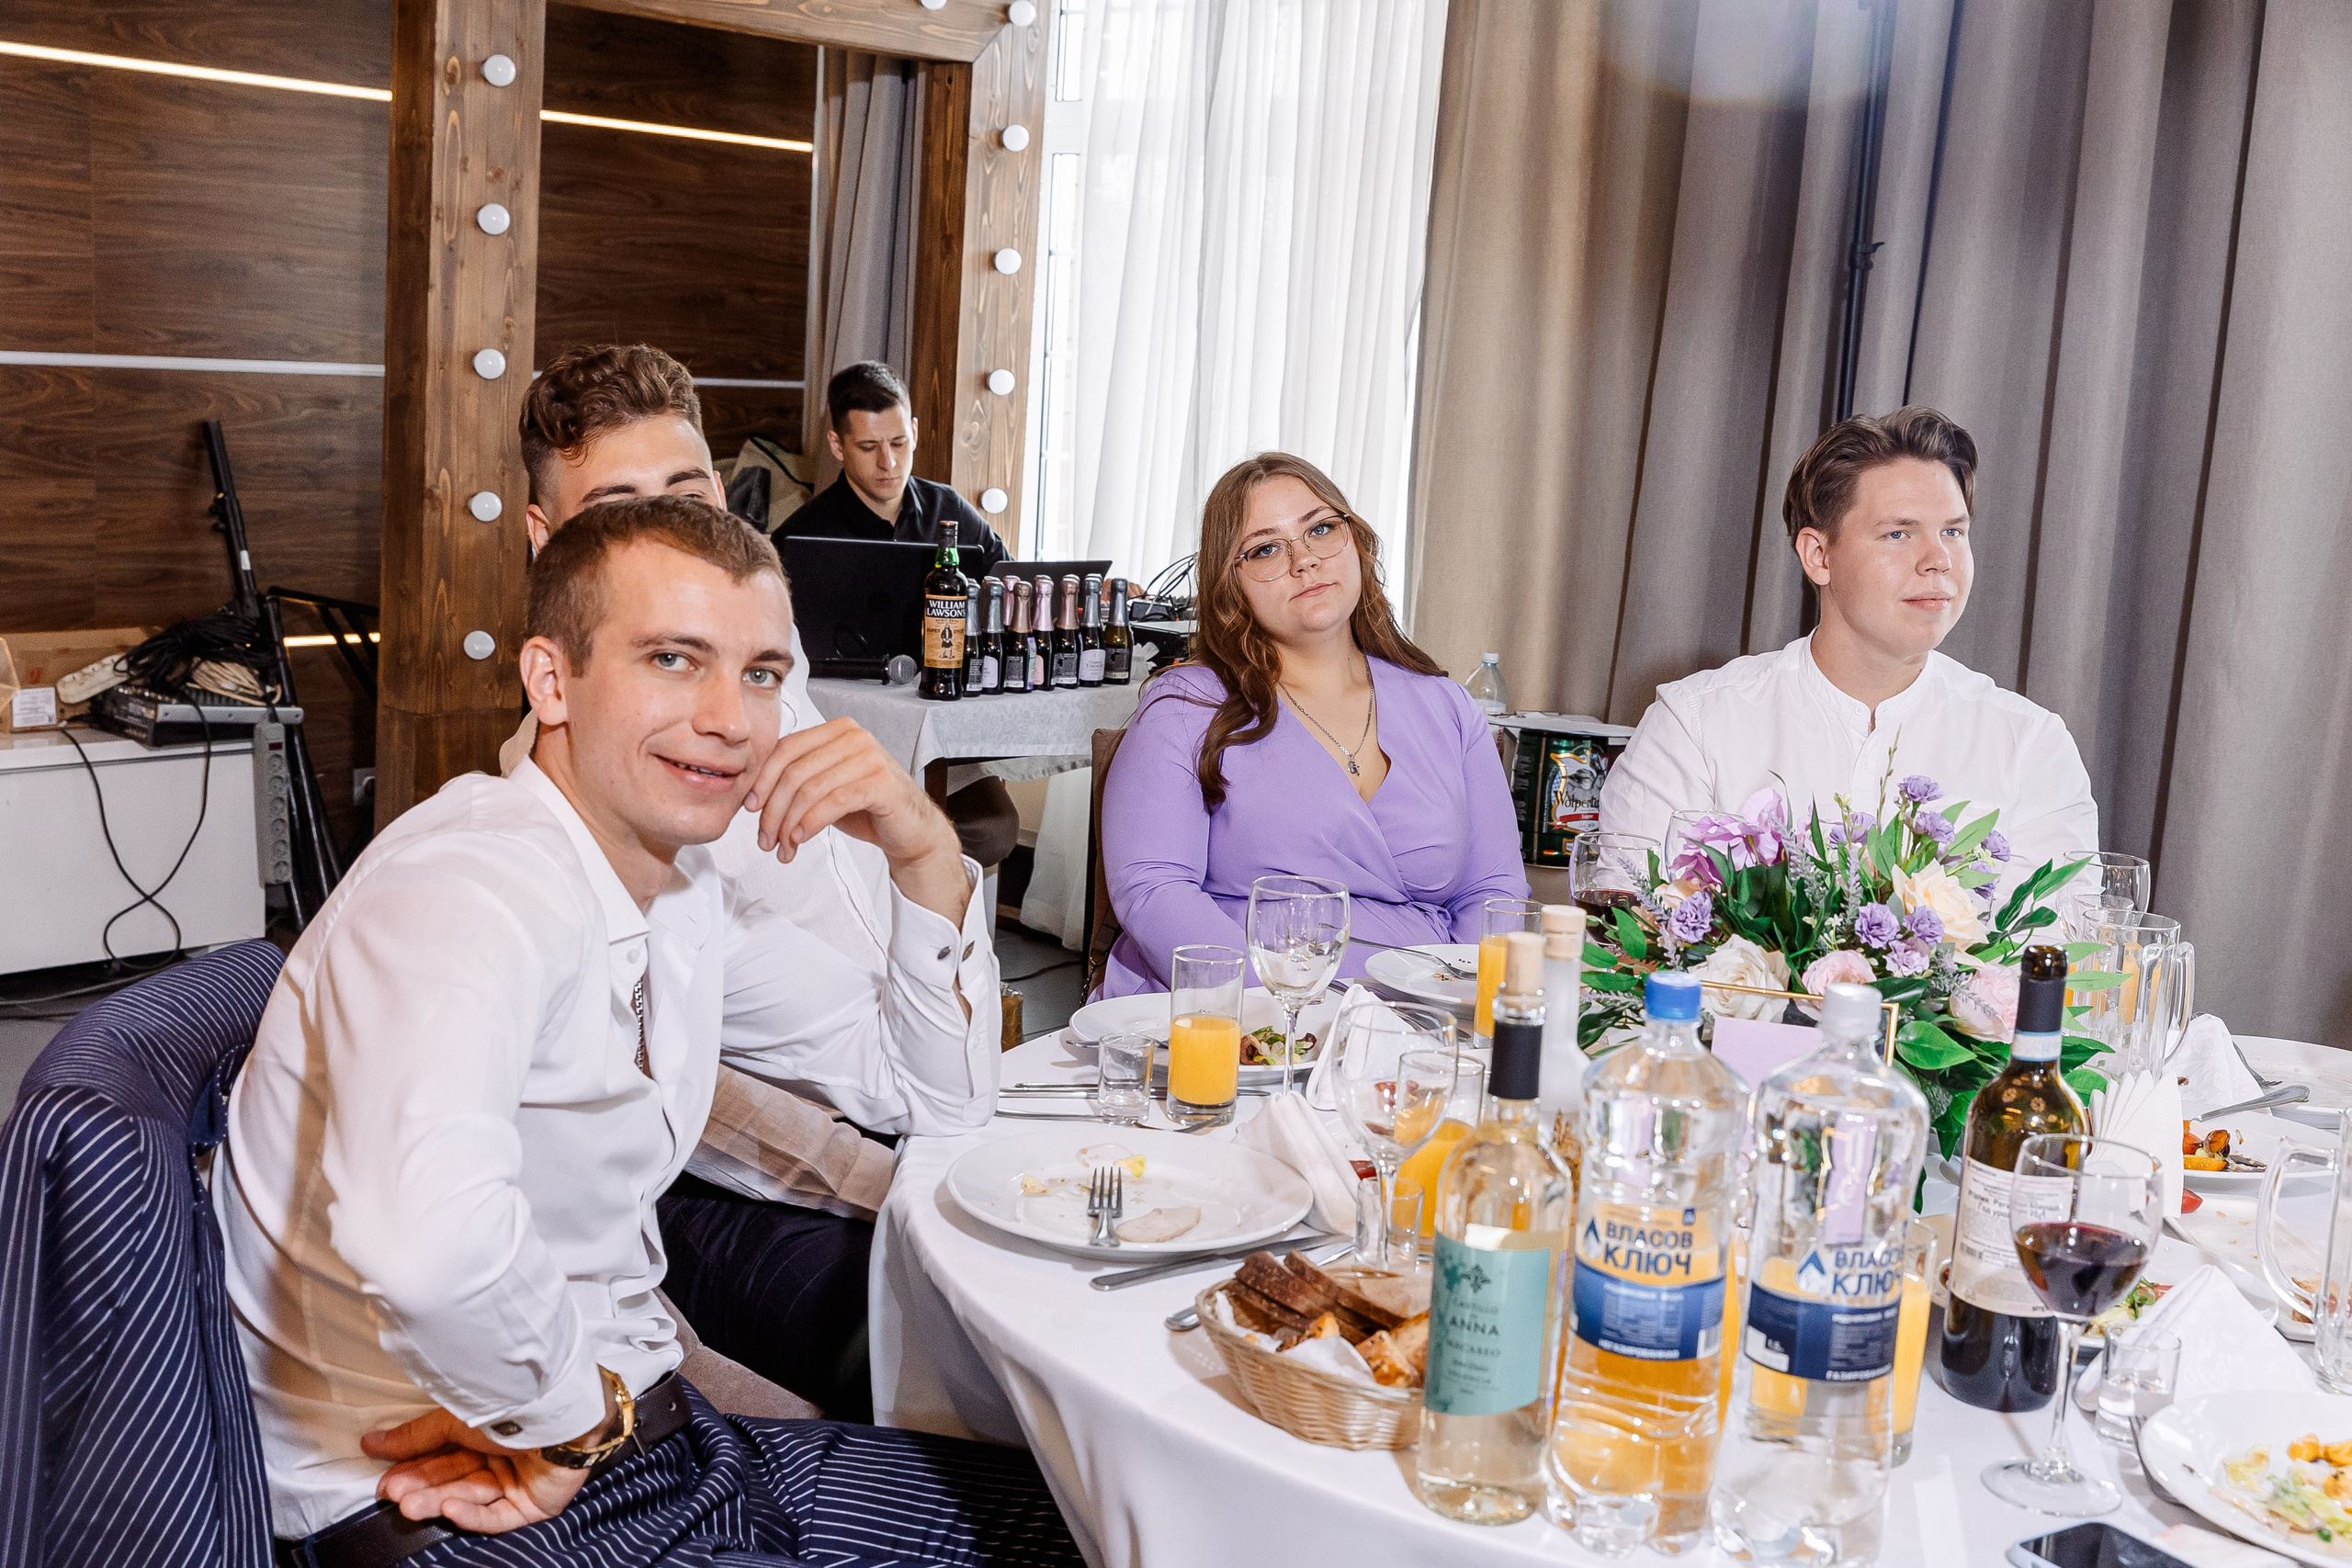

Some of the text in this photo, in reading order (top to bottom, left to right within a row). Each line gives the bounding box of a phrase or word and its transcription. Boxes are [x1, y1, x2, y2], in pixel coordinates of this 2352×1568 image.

[929, 600, 966, 610] WILLIAM
[1606, 1221, 1693, 1249] ВЛАСОВ
[1604, 1243, 1691, 1276] КЛЮЧ
[1449, 1315, 1499, 1337] ANNA
